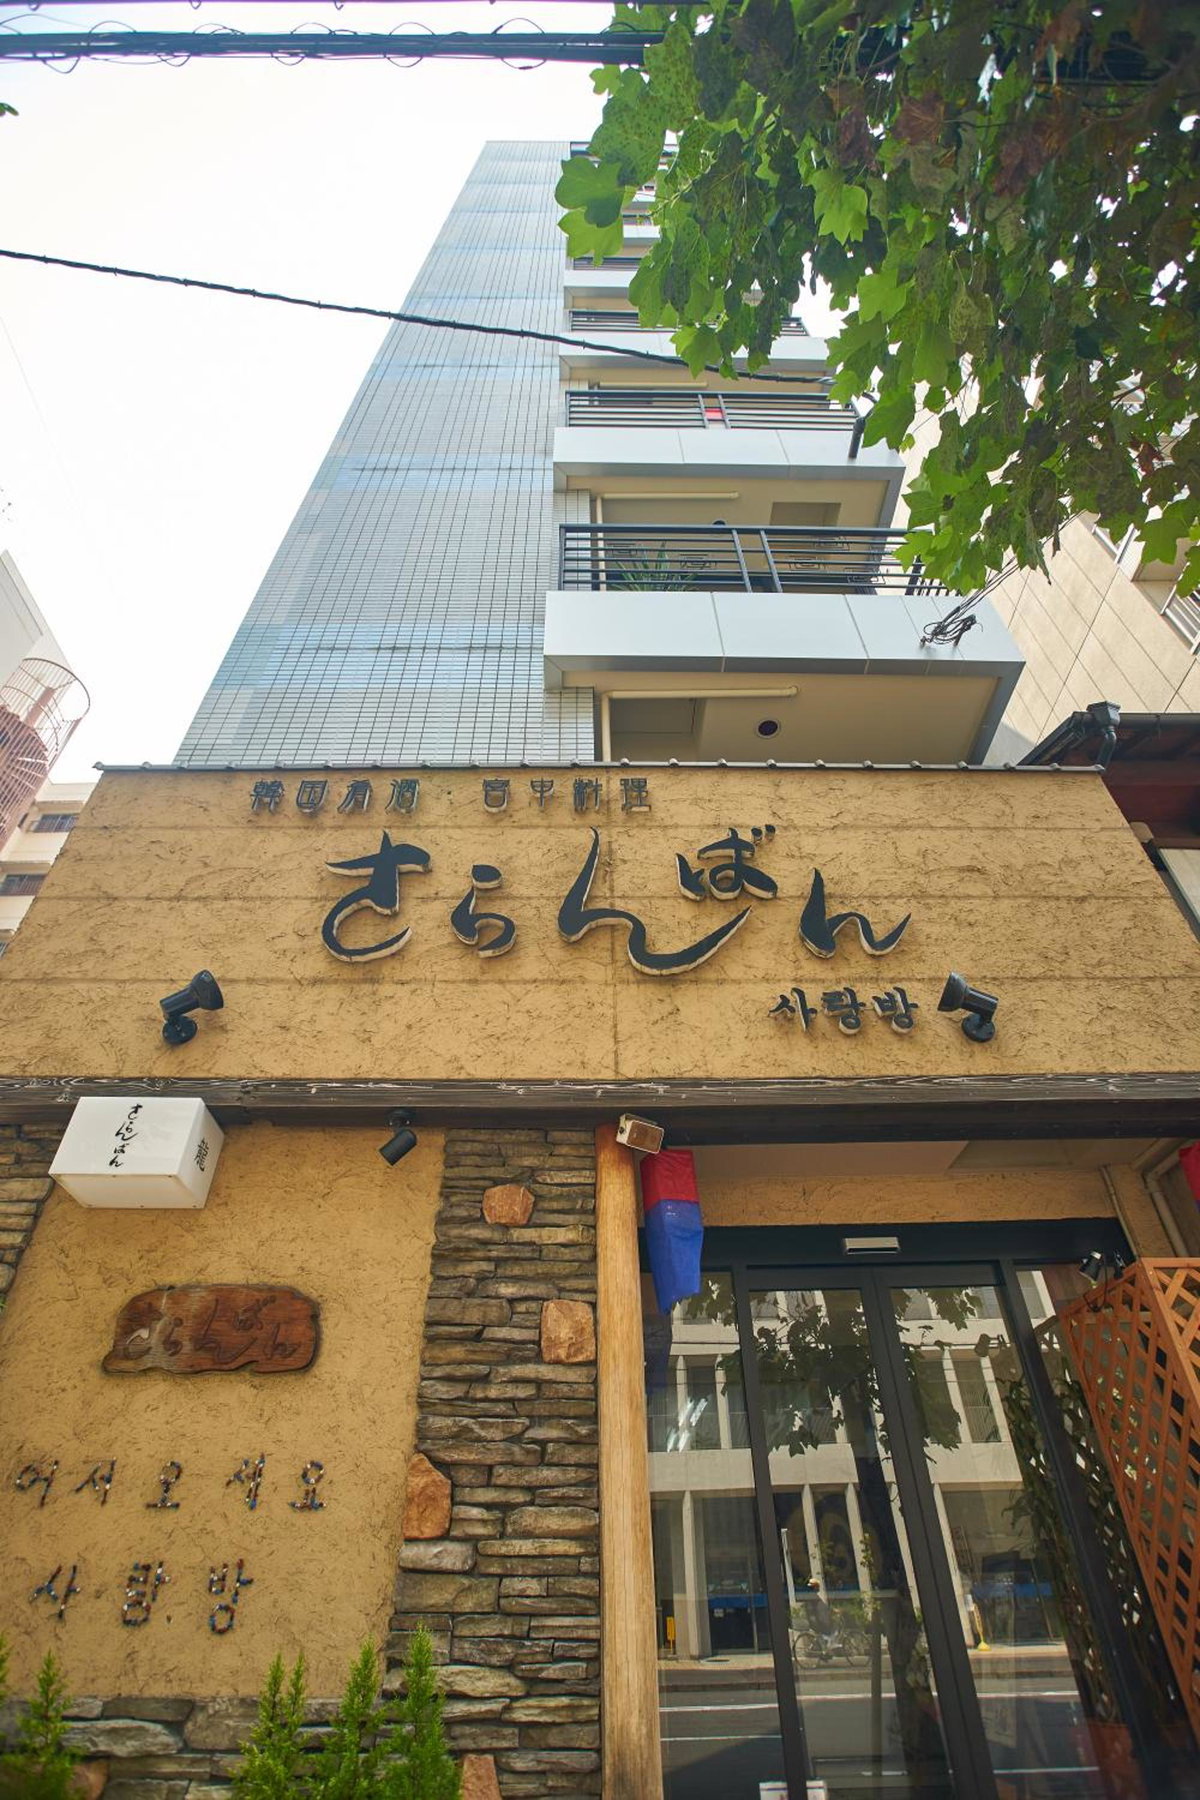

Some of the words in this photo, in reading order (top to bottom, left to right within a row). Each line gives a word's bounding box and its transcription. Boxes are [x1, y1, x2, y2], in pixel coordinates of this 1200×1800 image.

[321, 824, 912, 977] さらんばん
[767, 986, 920, 1035] 사랑방
[108, 1103, 144, 1168] さらんばん
[29, 1558, 254, 1635] 사랑방
